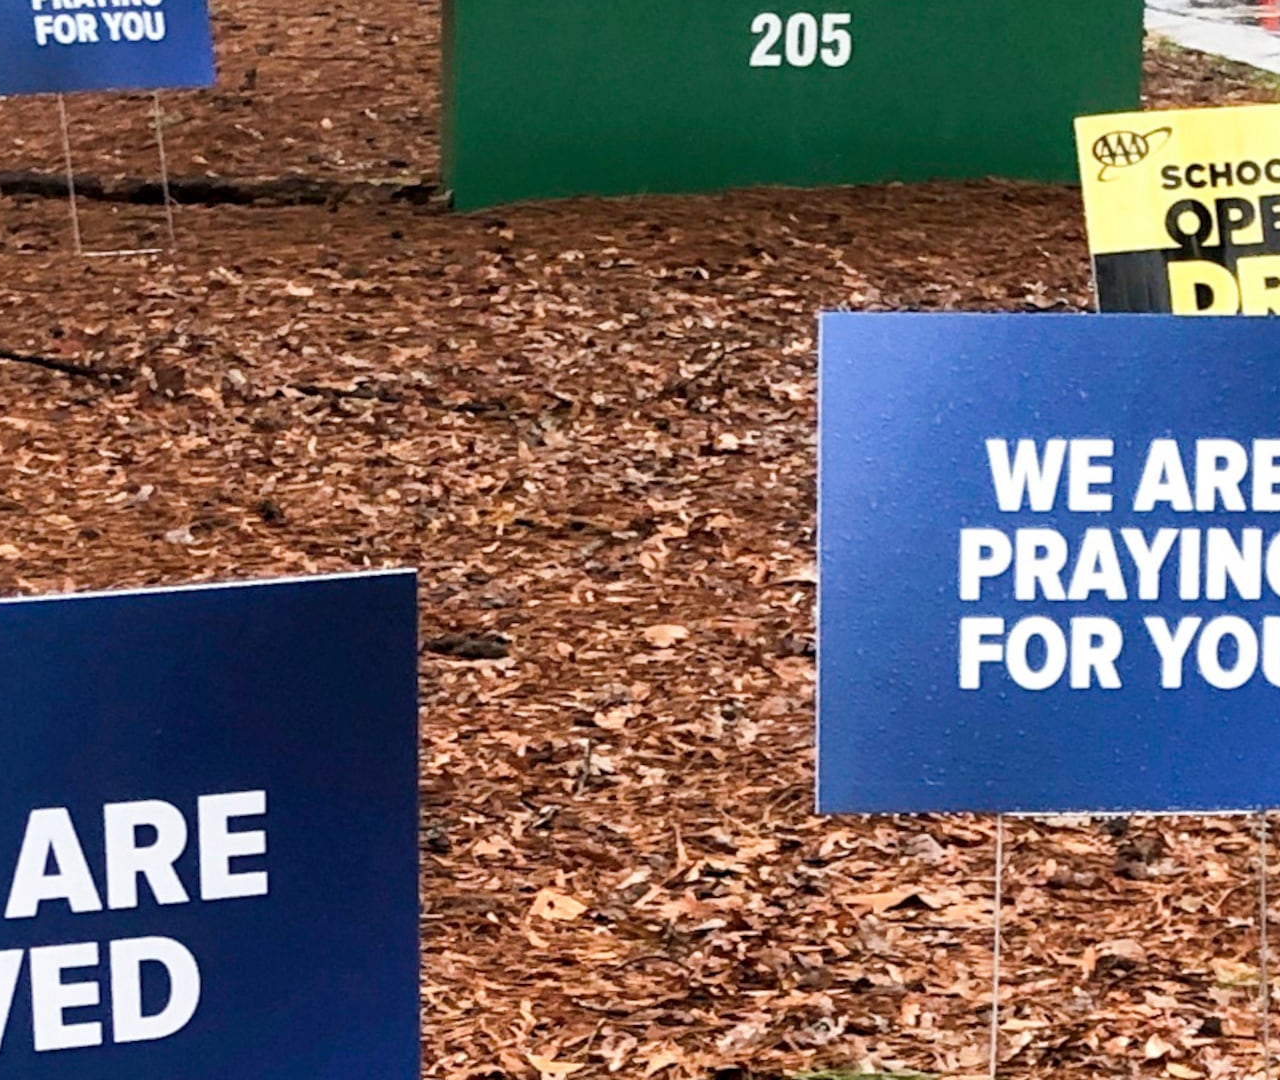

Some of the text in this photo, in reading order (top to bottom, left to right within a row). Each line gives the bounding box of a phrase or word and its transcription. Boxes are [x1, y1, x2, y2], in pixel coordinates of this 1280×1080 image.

[34, 10, 166, 46] FOR YOU
[749, 12, 852, 67] 205
[1098, 132, 1147, 166] AAA
[985, 437, 1114, 512] WE
[958, 615, 1123, 690] FOR
[4, 789, 269, 919] ARE
